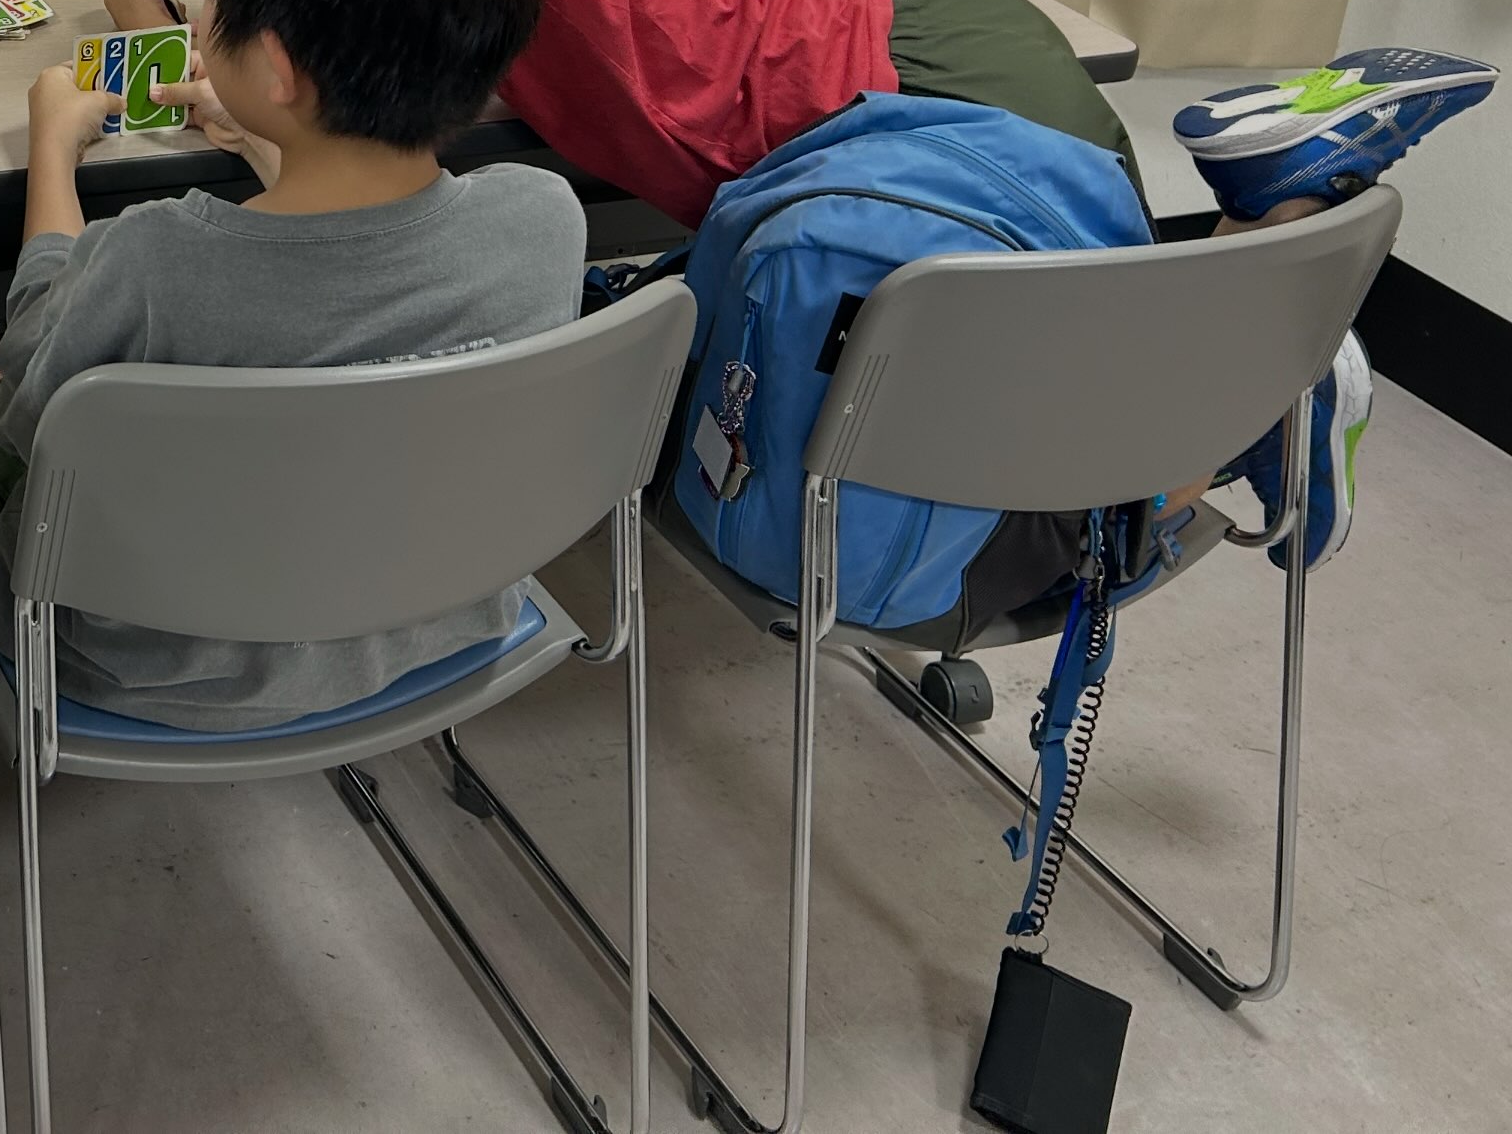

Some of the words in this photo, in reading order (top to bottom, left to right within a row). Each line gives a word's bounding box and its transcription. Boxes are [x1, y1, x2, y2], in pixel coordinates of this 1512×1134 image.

[81, 41, 95, 61] 6
[109, 41, 123, 58] 2
[134, 38, 144, 56] 1
[170, 106, 180, 123] 1
